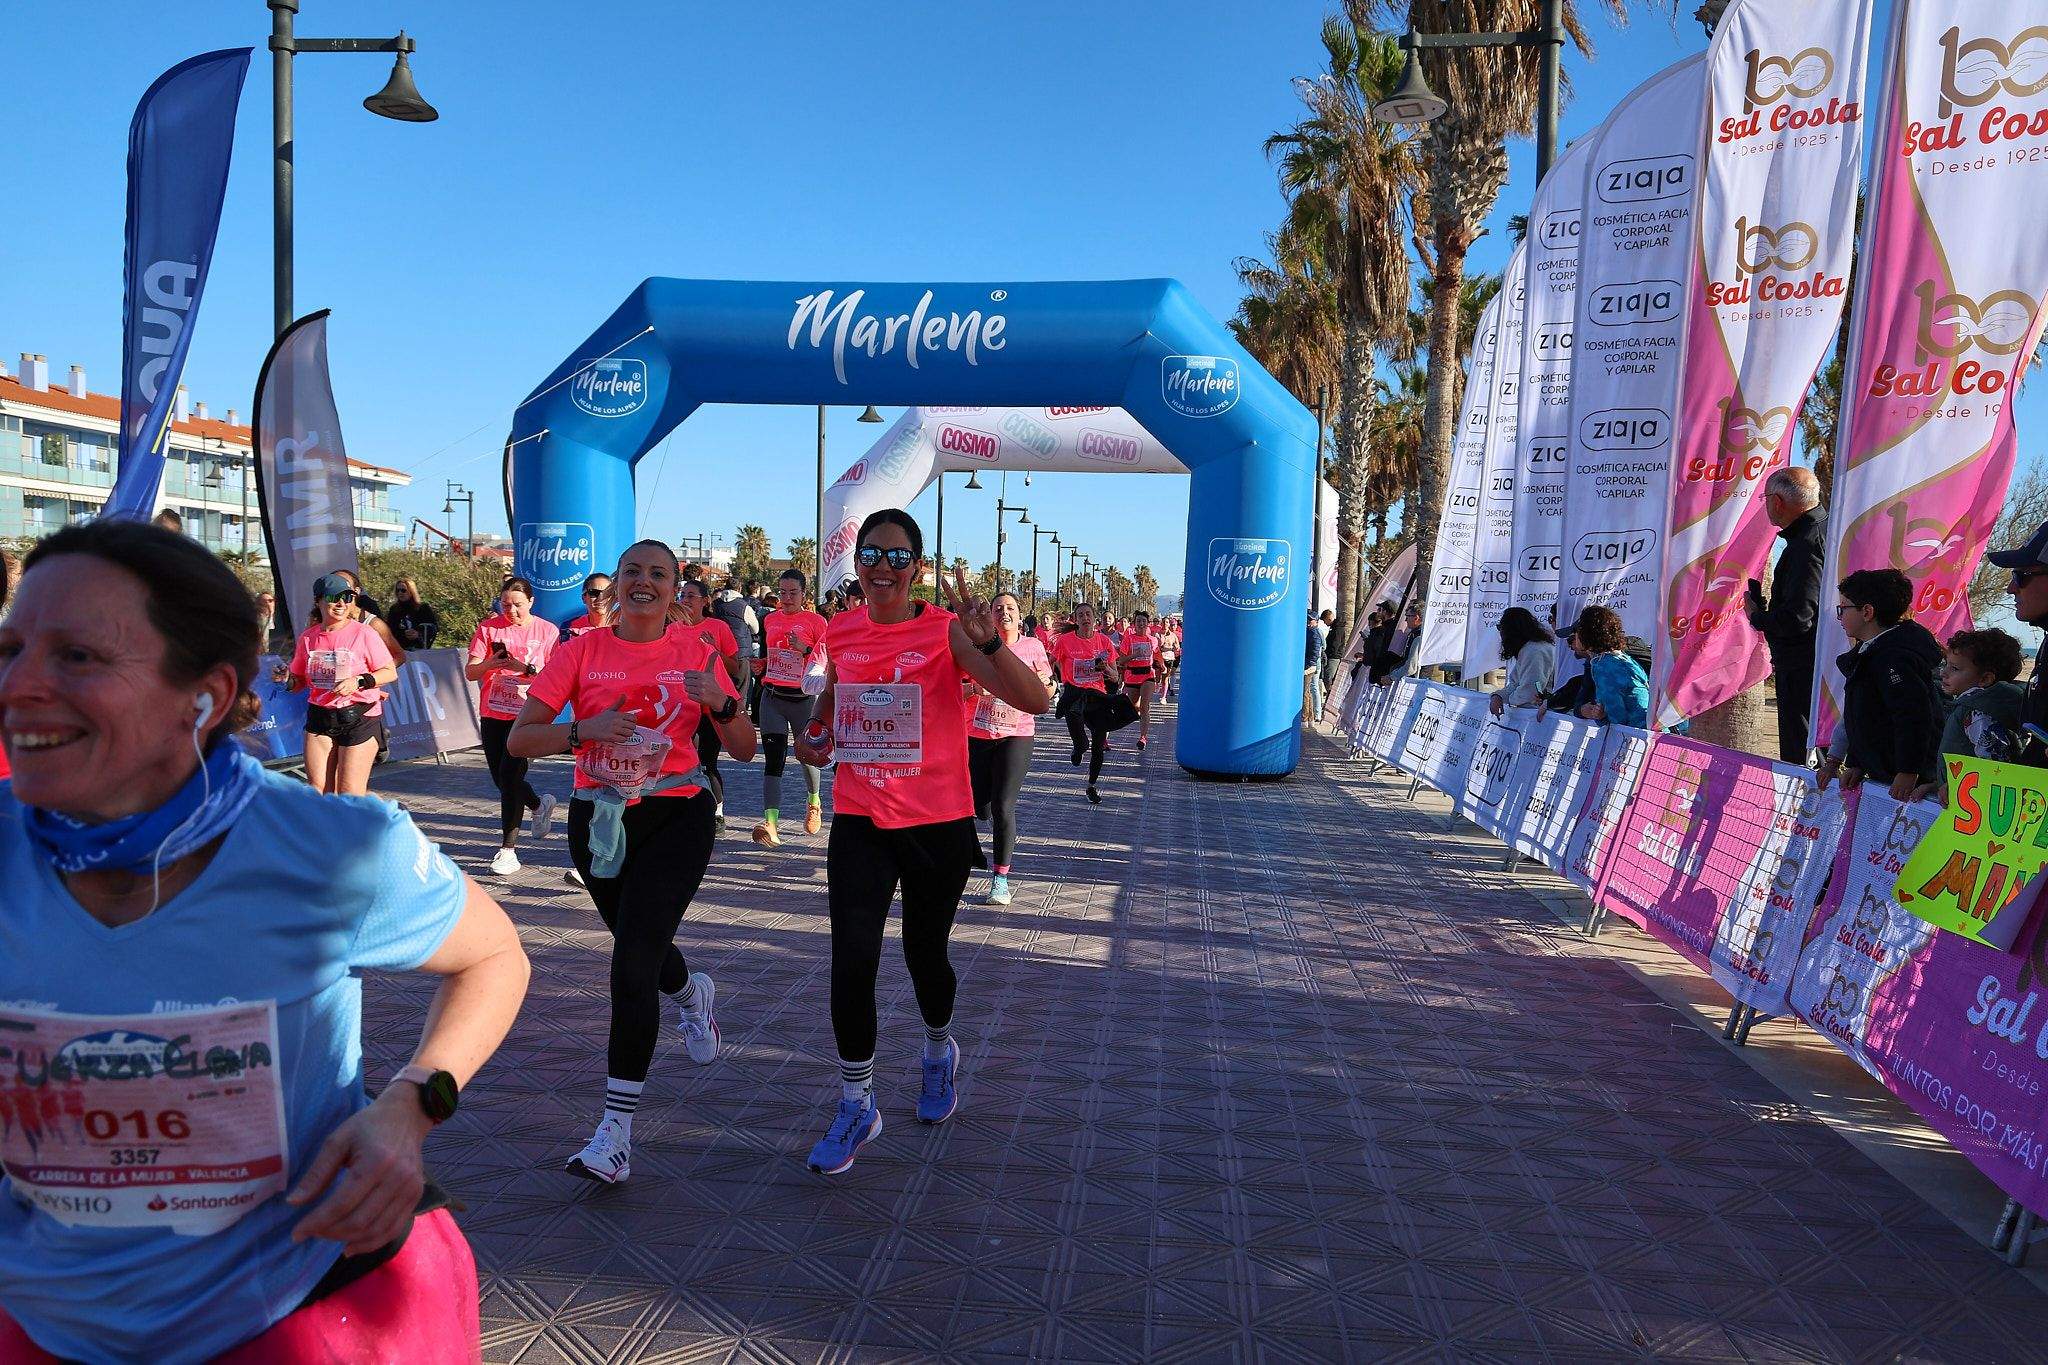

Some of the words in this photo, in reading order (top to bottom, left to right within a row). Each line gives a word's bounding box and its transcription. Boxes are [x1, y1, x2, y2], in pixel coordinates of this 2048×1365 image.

[1717, 109, 1762, 144] Sal
[1769, 97, 1862, 131] Costa
[1740, 141, 1785, 157] Desde
[1792, 133, 1828, 149] 1925
[1901, 113, 1966, 158] Sal
[1931, 157, 1996, 176] Desde
[1608, 165, 1684, 194] ziaja
[1593, 210, 1656, 227] COSMÉTICA
[1612, 223, 1674, 238] CORPORAL
[1615, 240, 1622, 251] Y
[1623, 237, 1669, 250] CAPILAR
[1705, 279, 1751, 308] Sal
[1758, 271, 1846, 301] Costa
[1600, 291, 1671, 317] ziaja
[1731, 308, 1772, 323] Desde
[1778, 305, 1814, 318] 1925
[788, 289, 1006, 385] Marlene
[1584, 338, 1641, 352] COSMÉTICA
[1604, 351, 1659, 363] CORPORAL
[1605, 366, 1613, 376] Y
[1614, 364, 1656, 376] CAPILAR
[1870, 361, 1942, 398] Sal
[1951, 360, 2010, 396] Co
[576, 370, 642, 401] Marlene
[1168, 369, 1235, 402] Marlene
[592, 405, 604, 413] DE
[603, 406, 617, 414] LOS
[617, 401, 638, 414] ALPES
[1185, 405, 1195, 414] DE
[1195, 406, 1209, 414] LOS
[1209, 399, 1229, 413] ALPES
[1905, 405, 1971, 420] Desde
[941, 427, 996, 459] COSMO
[1592, 418, 1658, 445] ziaja
[1081, 432, 1138, 461] COSMO
[1595, 476, 1648, 486] CORPORAL
[1687, 455, 1736, 483] Sal
[279, 430, 338, 551] IMR
[1712, 487, 1751, 500] Desd
[522, 538, 589, 572] Marlene
[1584, 538, 1646, 564] ziaja
[536, 577, 546, 586] DE
[546, 579, 561, 587] LOS
[561, 571, 583, 586] ALPES
[1212, 554, 1285, 590] Marlene
[1230, 594, 1241, 604] DE
[1241, 598, 1257, 606] LOS
[1257, 591, 1279, 605] ALPES
[588, 671, 627, 680] OYSHO
[862, 719, 895, 733] 016
[1836, 924, 1855, 946] Sal
[1854, 935, 1885, 964] Costa
[1809, 1003, 1827, 1021] Sal
[1966, 975, 2039, 1045] Sal
[1982, 1050, 2040, 1096] Desde
[84, 1109, 192, 1140] 016
[1955, 1093, 1997, 1140] POR
[2000, 1123, 2043, 1170] MÁS
[110, 1149, 161, 1166] 3357
[90, 1168, 106, 1184] DE
[110, 1168, 127, 1184] LA
[132, 1168, 176, 1182] MUJER
[187, 1167, 249, 1181] VALENCIA
[171, 1190, 256, 1211] Santander
